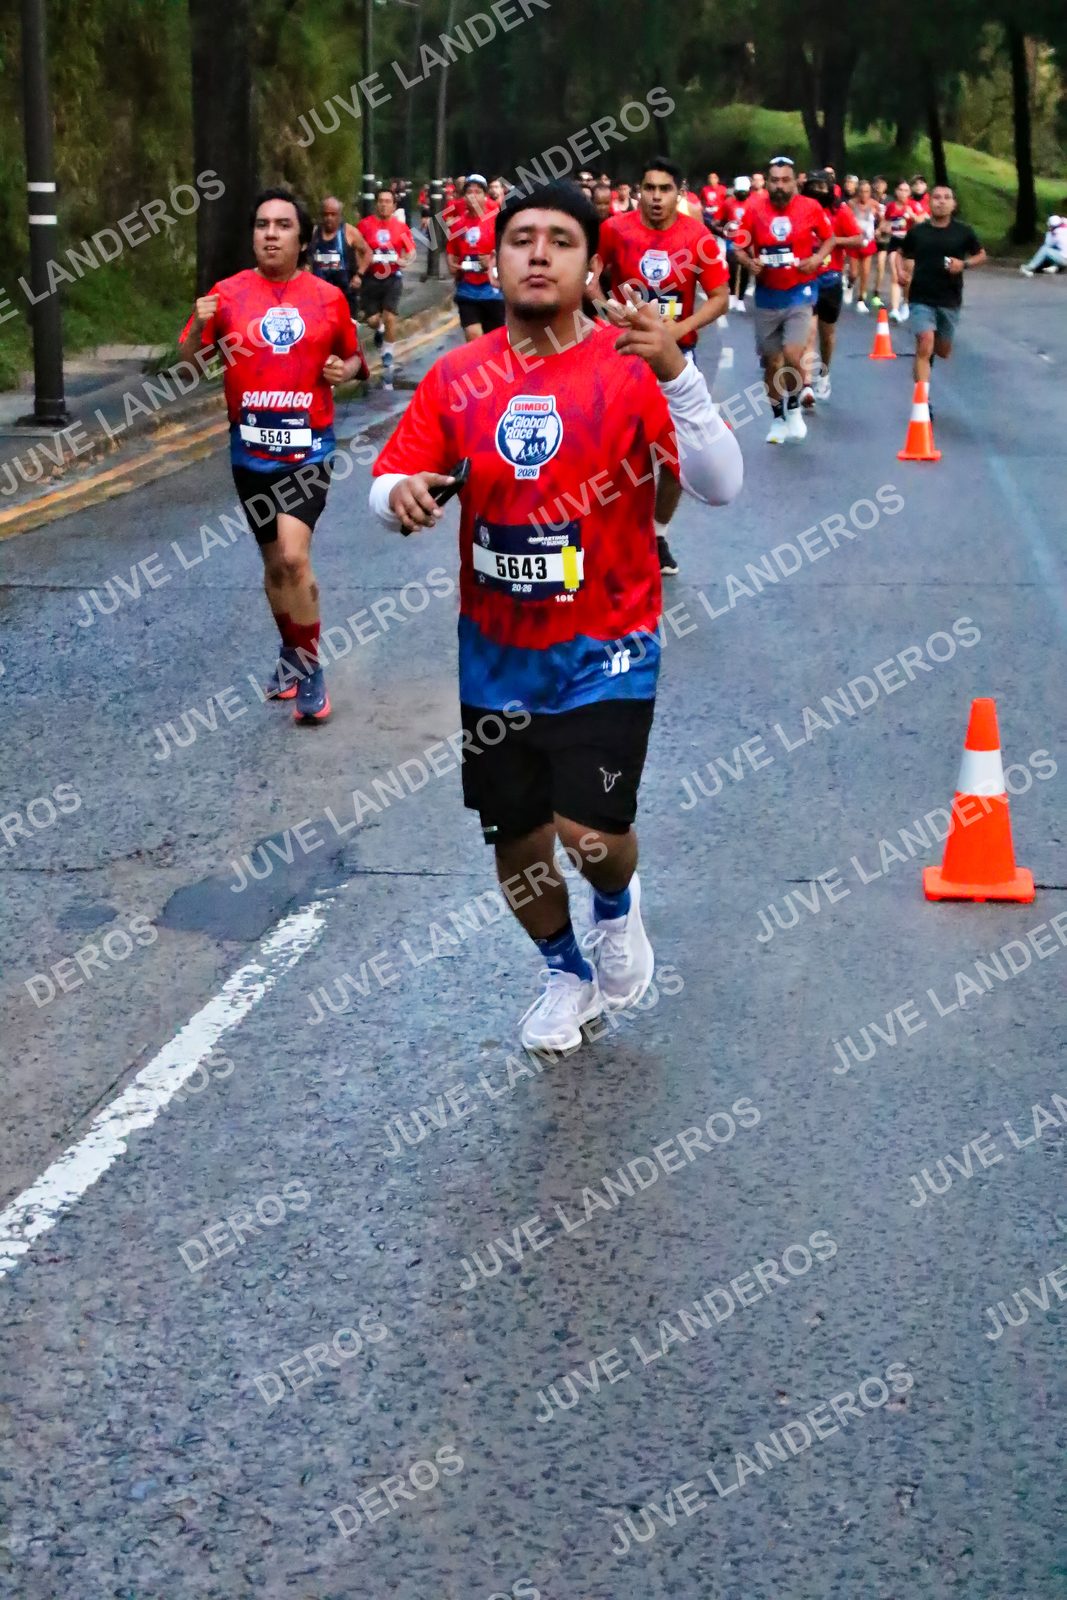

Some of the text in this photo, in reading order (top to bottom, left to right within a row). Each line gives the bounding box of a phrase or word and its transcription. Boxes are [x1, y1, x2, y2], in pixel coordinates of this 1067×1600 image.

[242, 391, 313, 408] SANTIAGO
[514, 403, 549, 411] BIMBO
[513, 416, 548, 428] Global
[260, 430, 291, 444] 5543
[506, 428, 533, 439] Race
[517, 469, 537, 477] 2026
[495, 555, 547, 579] 5643
[555, 594, 574, 602] 10K
